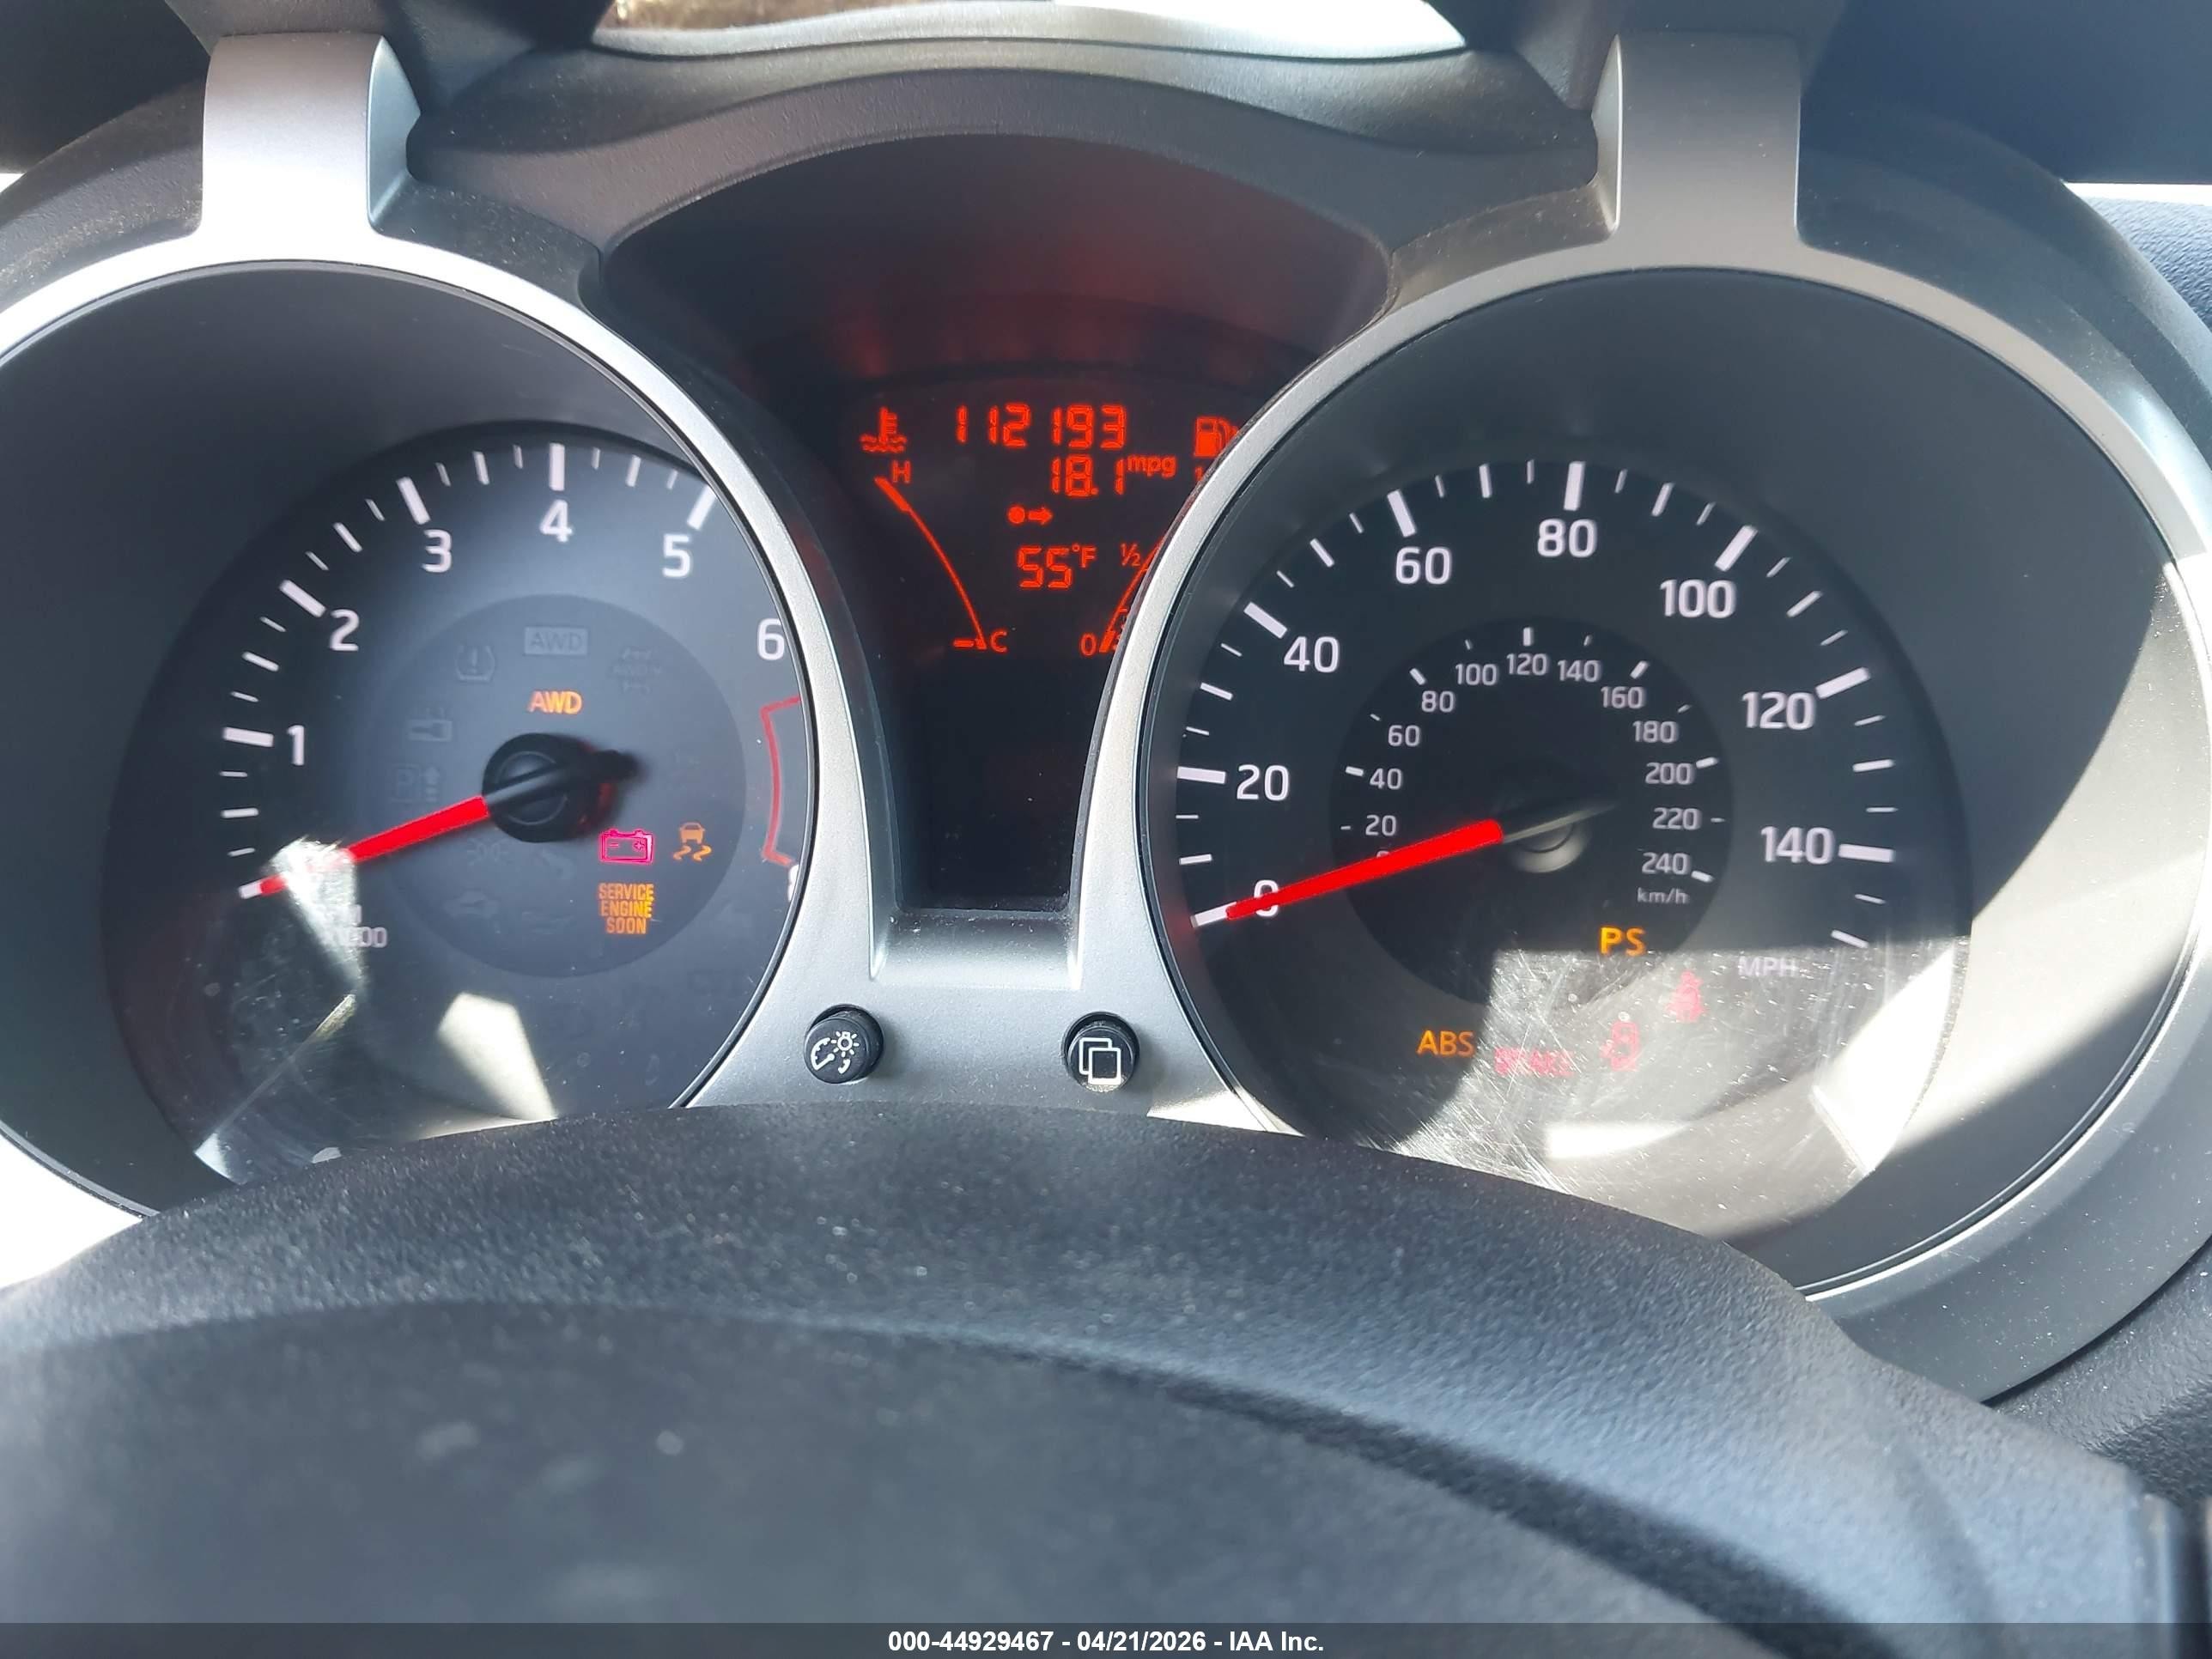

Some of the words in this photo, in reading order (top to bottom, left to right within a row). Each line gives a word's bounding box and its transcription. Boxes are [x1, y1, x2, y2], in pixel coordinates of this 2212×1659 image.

[957, 404, 1127, 449] 112193
[891, 462, 911, 483] H
[541, 501, 572, 542] 4
[1538, 519, 1597, 558] 80
[423, 529, 452, 573] 3
[662, 533, 691, 578] 5
[1396, 546, 1451, 585] 60
[1661, 580, 1735, 619] 100
[331, 610, 359, 651] 2
[757, 618, 784, 660] 6
[990, 630, 1008, 653] C
[1283, 635, 1340, 672] 40
[1507, 653, 1548, 676] 120
[1455, 663, 1498, 686] 100
[1558, 659, 1600, 683] 140
[529, 690, 583, 714] AWD
[1421, 690, 1455, 713] 80
[1601, 686, 1644, 709] 160
[1743, 692, 1814, 730] 120
[1388, 725, 1420, 747] 60
[1633, 720, 1677, 744] 180
[288, 725, 305, 766] 1
[1237, 764, 1290, 801] 20
[1370, 768, 1402, 790] 40
[1645, 762, 1692, 785] 200
[1365, 814, 1396, 836] 20
[1653, 807, 1699, 830] 220
[1761, 827, 1832, 865] 140
[1642, 852, 1688, 875] 240
[599, 884, 654, 900] SERVICE
[1637, 887, 1688, 904] km/h
[599, 901, 653, 917] ENGINE
[606, 917, 647, 934] SOON
[1600, 927, 1646, 956] PS
[1738, 956, 1797, 977] MPH
[1417, 1030, 1474, 1057] ABS
